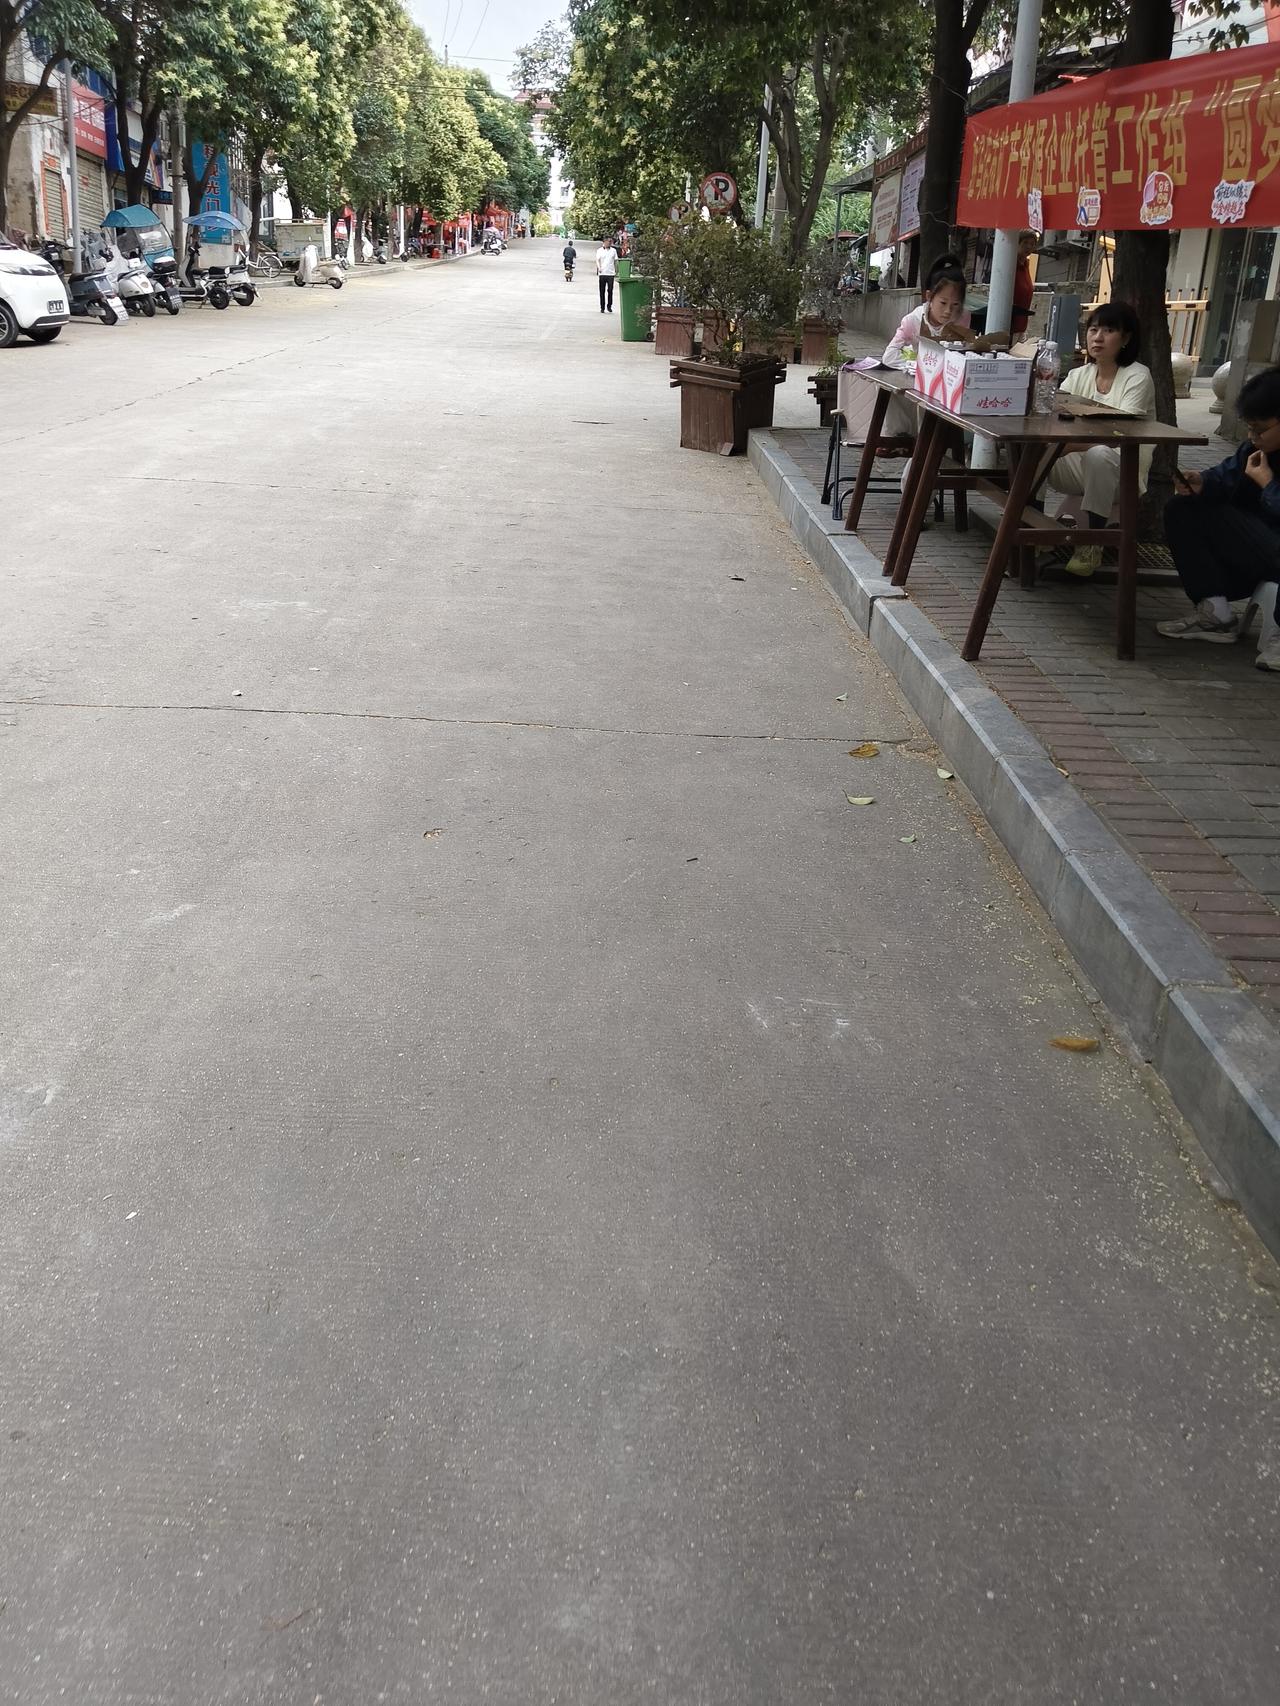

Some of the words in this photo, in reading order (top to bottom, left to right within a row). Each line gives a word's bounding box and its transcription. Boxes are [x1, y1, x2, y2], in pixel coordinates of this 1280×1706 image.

[714, 178, 730, 200] P
[977, 396, 1012, 409] 娃哈哈
